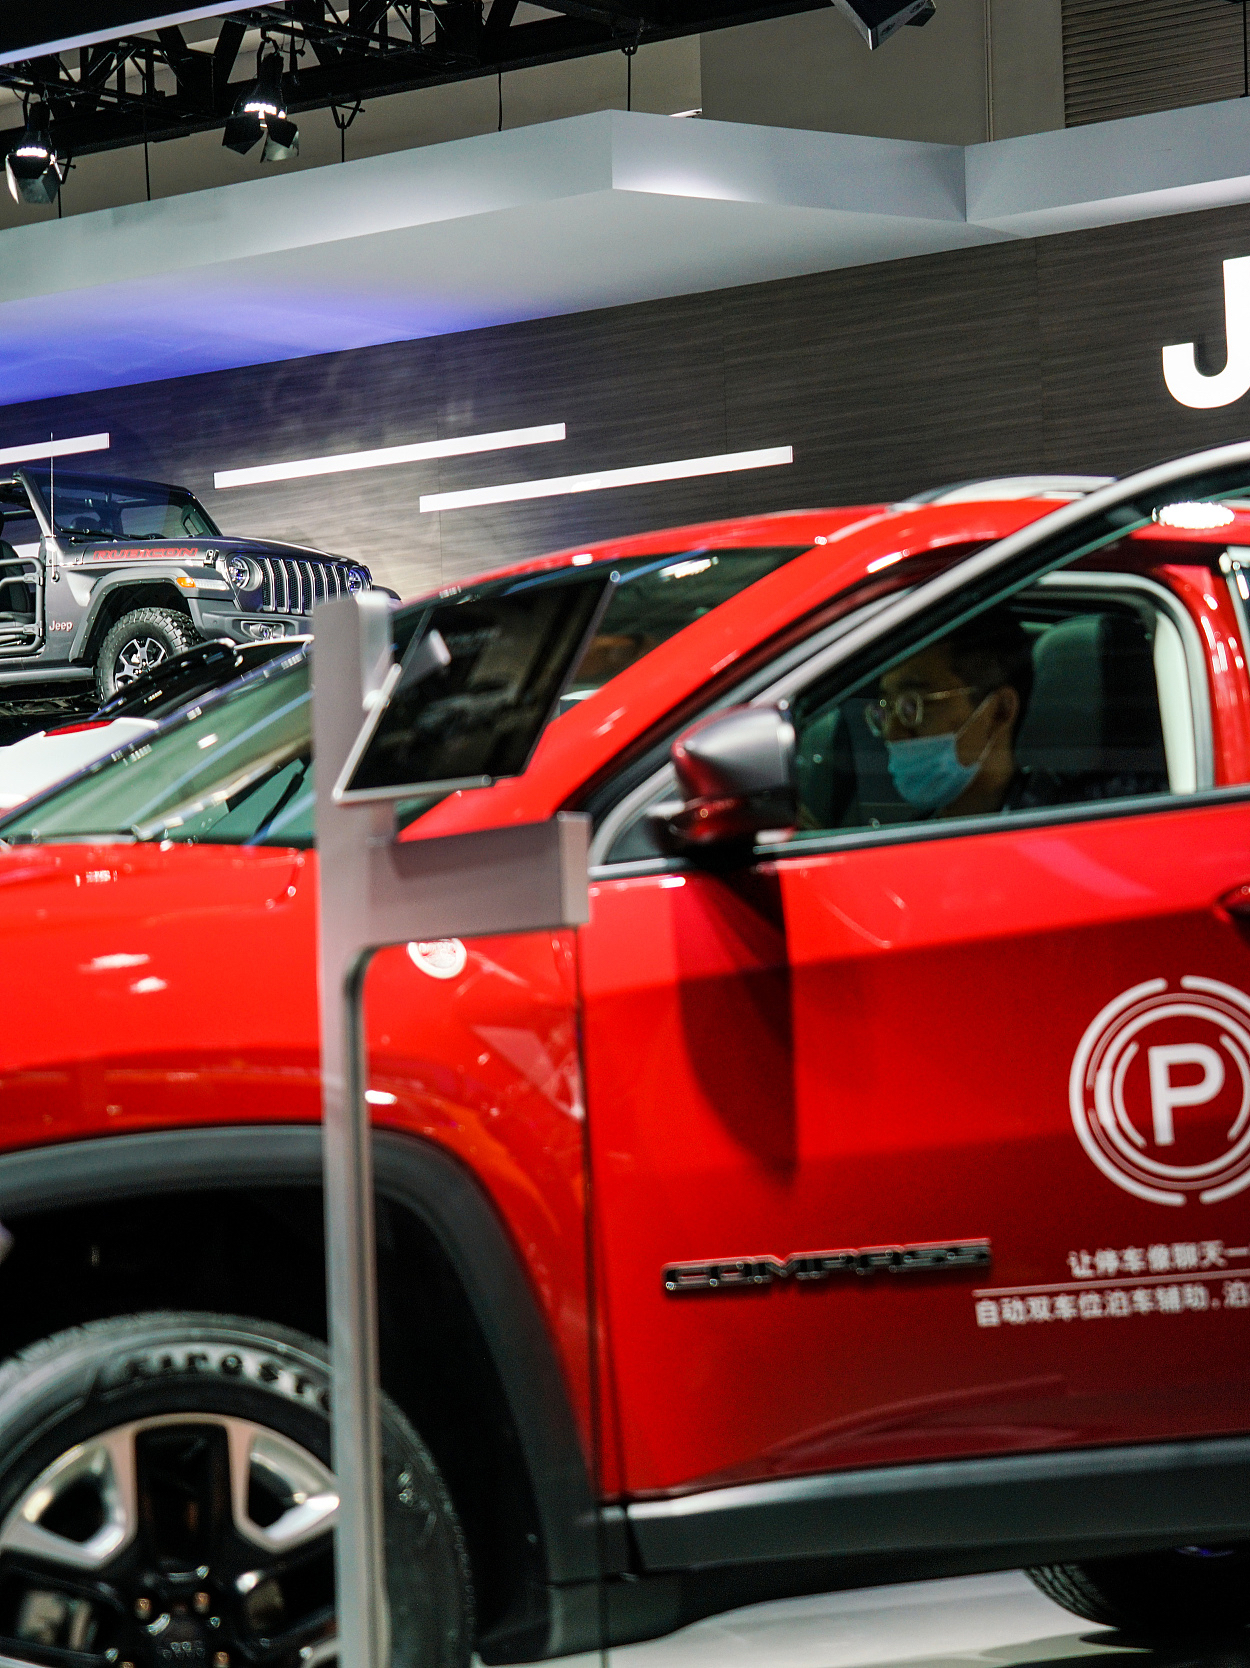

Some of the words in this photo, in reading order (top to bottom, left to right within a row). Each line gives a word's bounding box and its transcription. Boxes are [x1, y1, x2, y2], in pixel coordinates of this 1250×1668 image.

[93, 547, 199, 561] RUBICON
[49, 620, 73, 632] Jeep
[1147, 1042, 1226, 1147] P
